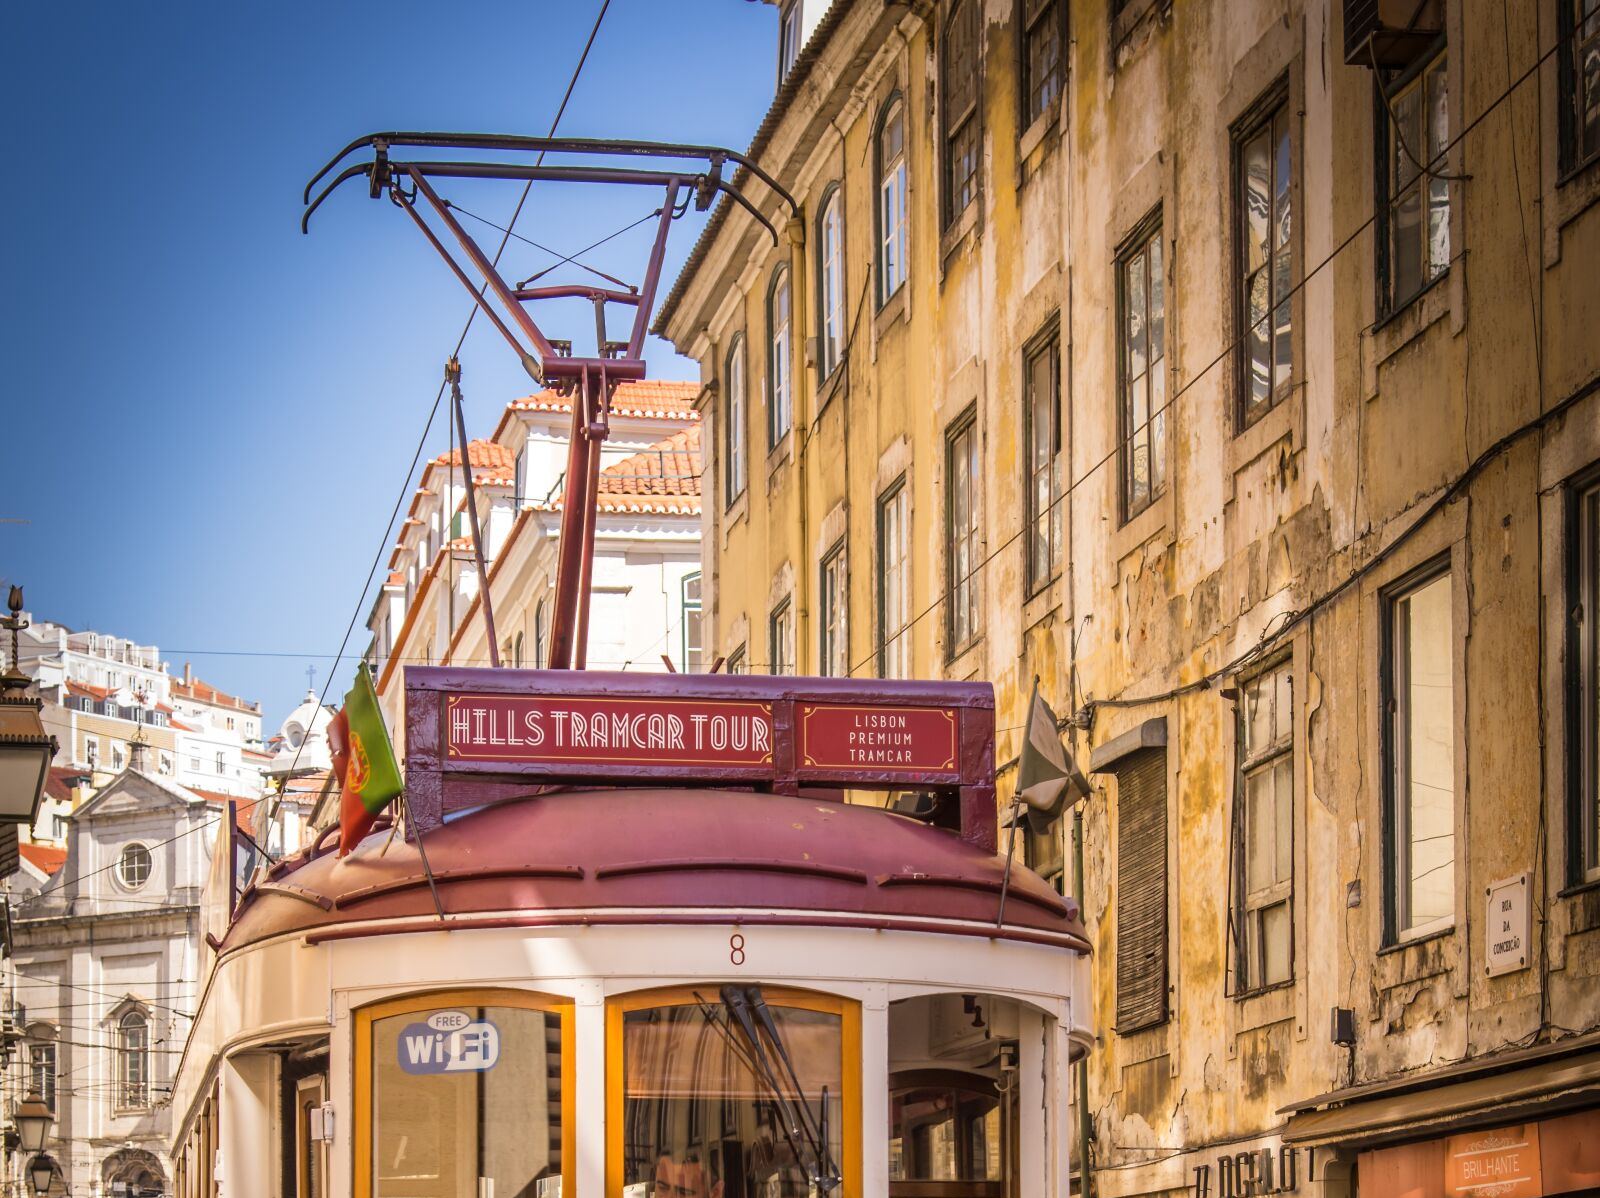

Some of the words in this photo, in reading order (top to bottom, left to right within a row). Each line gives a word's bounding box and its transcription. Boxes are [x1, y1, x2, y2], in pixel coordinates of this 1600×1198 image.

[855, 715, 906, 728] LISBON
[452, 708, 545, 746] HILLS
[551, 711, 685, 750] TRAMCAR
[690, 714, 770, 752] TOUR
[849, 732, 912, 745] PREMIUM
[849, 749, 912, 763] TRAMCAR
[1501, 900, 1512, 912] RUA
[1503, 920, 1511, 932] DA
[730, 934, 745, 966] 8
[435, 1015, 462, 1027] FREE
[1463, 1153, 1520, 1179] BRILHANTE
